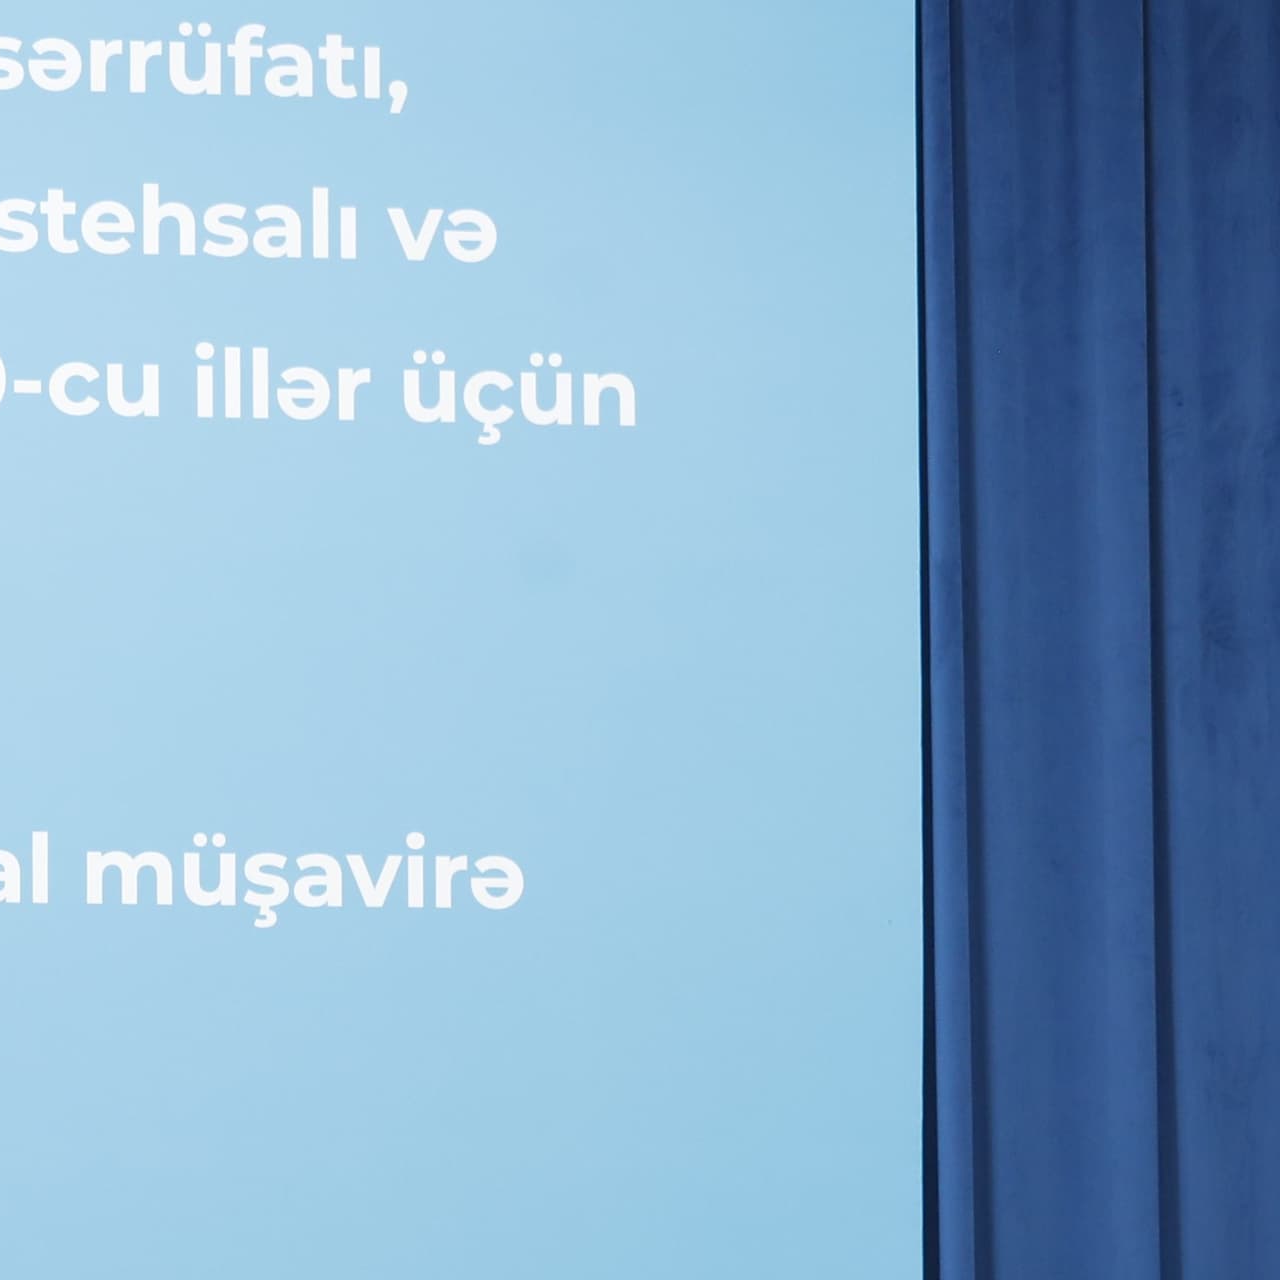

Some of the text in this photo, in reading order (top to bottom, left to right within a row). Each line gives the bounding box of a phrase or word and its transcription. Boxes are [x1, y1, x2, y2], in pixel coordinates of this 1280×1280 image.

[387, 208, 497, 263] və
[195, 342, 371, 420] illər
[403, 350, 636, 445] üçün
[86, 832, 524, 928] müşavirə
